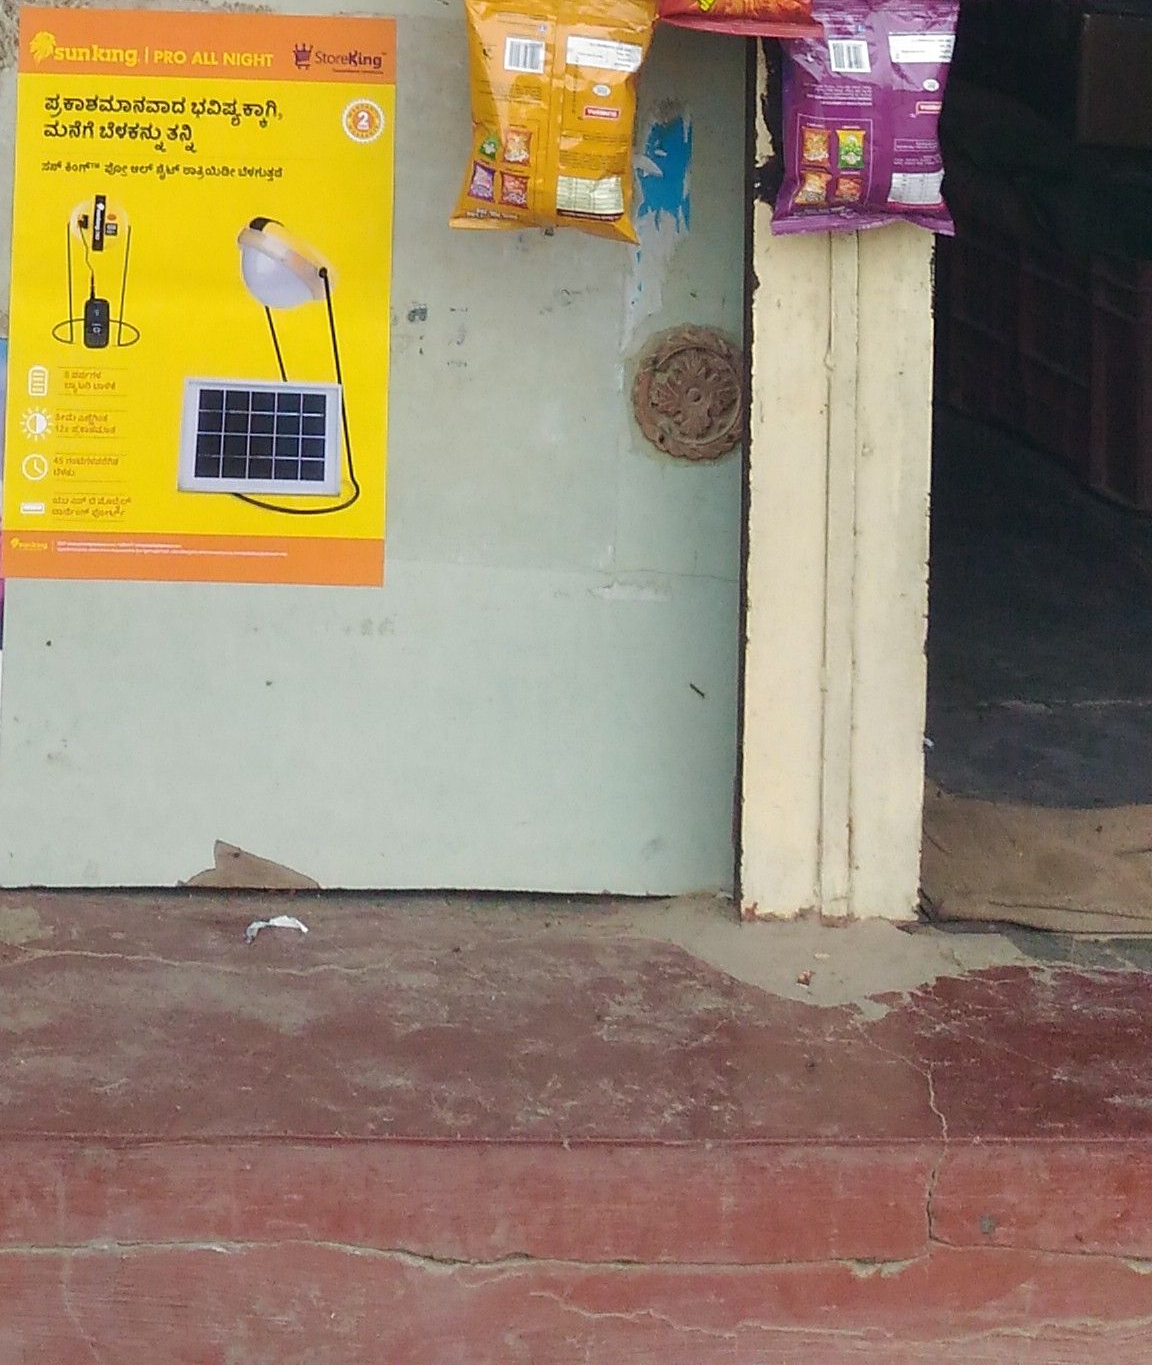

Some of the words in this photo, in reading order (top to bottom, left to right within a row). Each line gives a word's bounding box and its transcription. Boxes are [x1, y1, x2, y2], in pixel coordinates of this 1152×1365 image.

[54, 44, 138, 67] sunking
[154, 50, 186, 65] PRO
[192, 51, 219, 66] ALL
[223, 52, 274, 67] NIGHT
[315, 51, 382, 69] StoreKing
[44, 95, 186, 116] ಪ್ರಕಾಶಮಾನವಾದ
[356, 110, 370, 131] 2
[44, 122, 95, 139] ಮನೆಗೆ
[99, 123, 166, 152] ಬೆಳಕನ್ನು
[167, 125, 197, 153] ತನ್ನಿ
